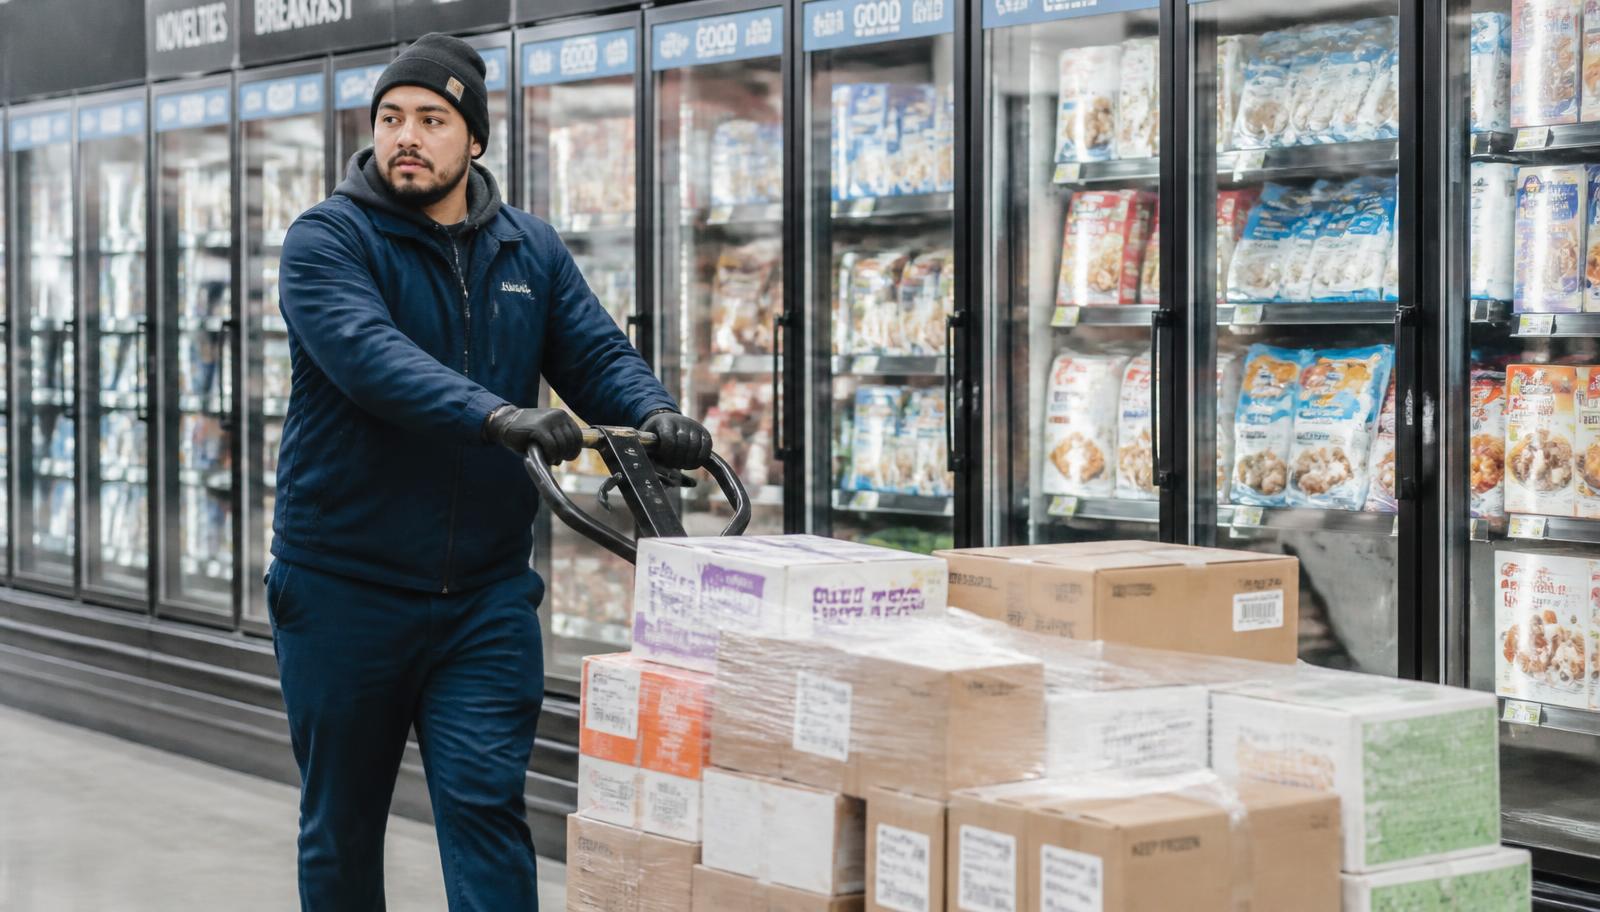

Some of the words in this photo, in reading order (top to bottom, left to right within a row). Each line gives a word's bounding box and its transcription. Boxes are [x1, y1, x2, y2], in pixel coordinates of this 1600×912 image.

[155, 2, 228, 51] NOVELTIES
[853, 0, 901, 28] GOOD
[696, 22, 738, 51] GOOD
